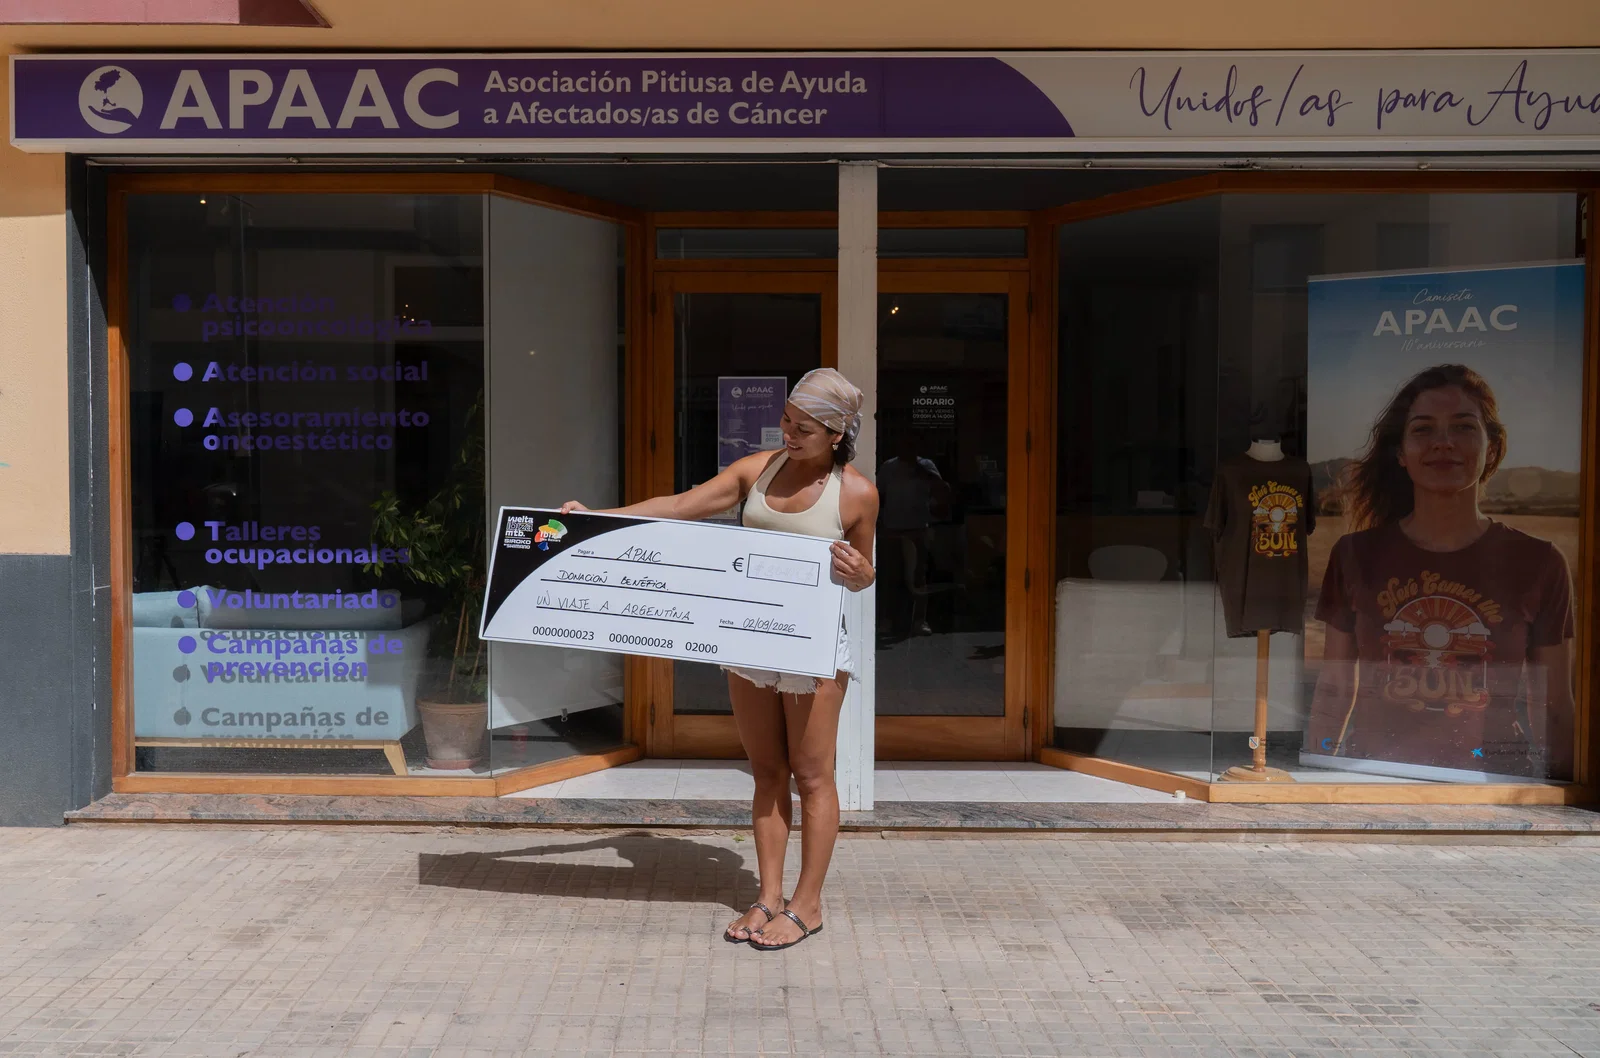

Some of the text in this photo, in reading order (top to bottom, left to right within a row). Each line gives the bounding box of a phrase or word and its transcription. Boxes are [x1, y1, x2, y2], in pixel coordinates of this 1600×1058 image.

[484, 70, 868, 99] Asociación Pitiusa de Ayuda
[159, 68, 460, 130] APAAC
[1129, 63, 1353, 131] Unidos/as
[1376, 86, 1464, 131] para
[483, 102, 828, 127] a Afectados/as de Cáncer
[201, 293, 335, 313] Atención
[1413, 288, 1475, 305] Camiseta
[202, 315, 432, 342] psicooncológica
[1373, 304, 1518, 337] APAAC
[1416, 338, 1487, 351] aniversario
[202, 360, 428, 382] Atención social
[912, 398, 955, 406] HORARIO
[202, 406, 430, 428] Asesoramiento
[203, 428, 393, 451] oncoestético
[204, 520, 321, 541] Talleres
[1259, 532, 1298, 550] SUN
[204, 543, 409, 570] ocupacionales
[577, 548, 591, 556] Pagar
[617, 545, 662, 563] APAAC
[732, 557, 744, 573] €
[206, 588, 397, 610] Voluntariado
[536, 590, 691, 621] UN VIAJE A ARGENTINA
[719, 618, 734, 626] Fecha
[207, 632, 404, 660] Campañas de
[532, 625, 718, 654] 0000000023 0000000028 02000
[207, 657, 369, 682] prevención
[1393, 666, 1481, 703] SUN
[200, 707, 390, 732] Campañas de
